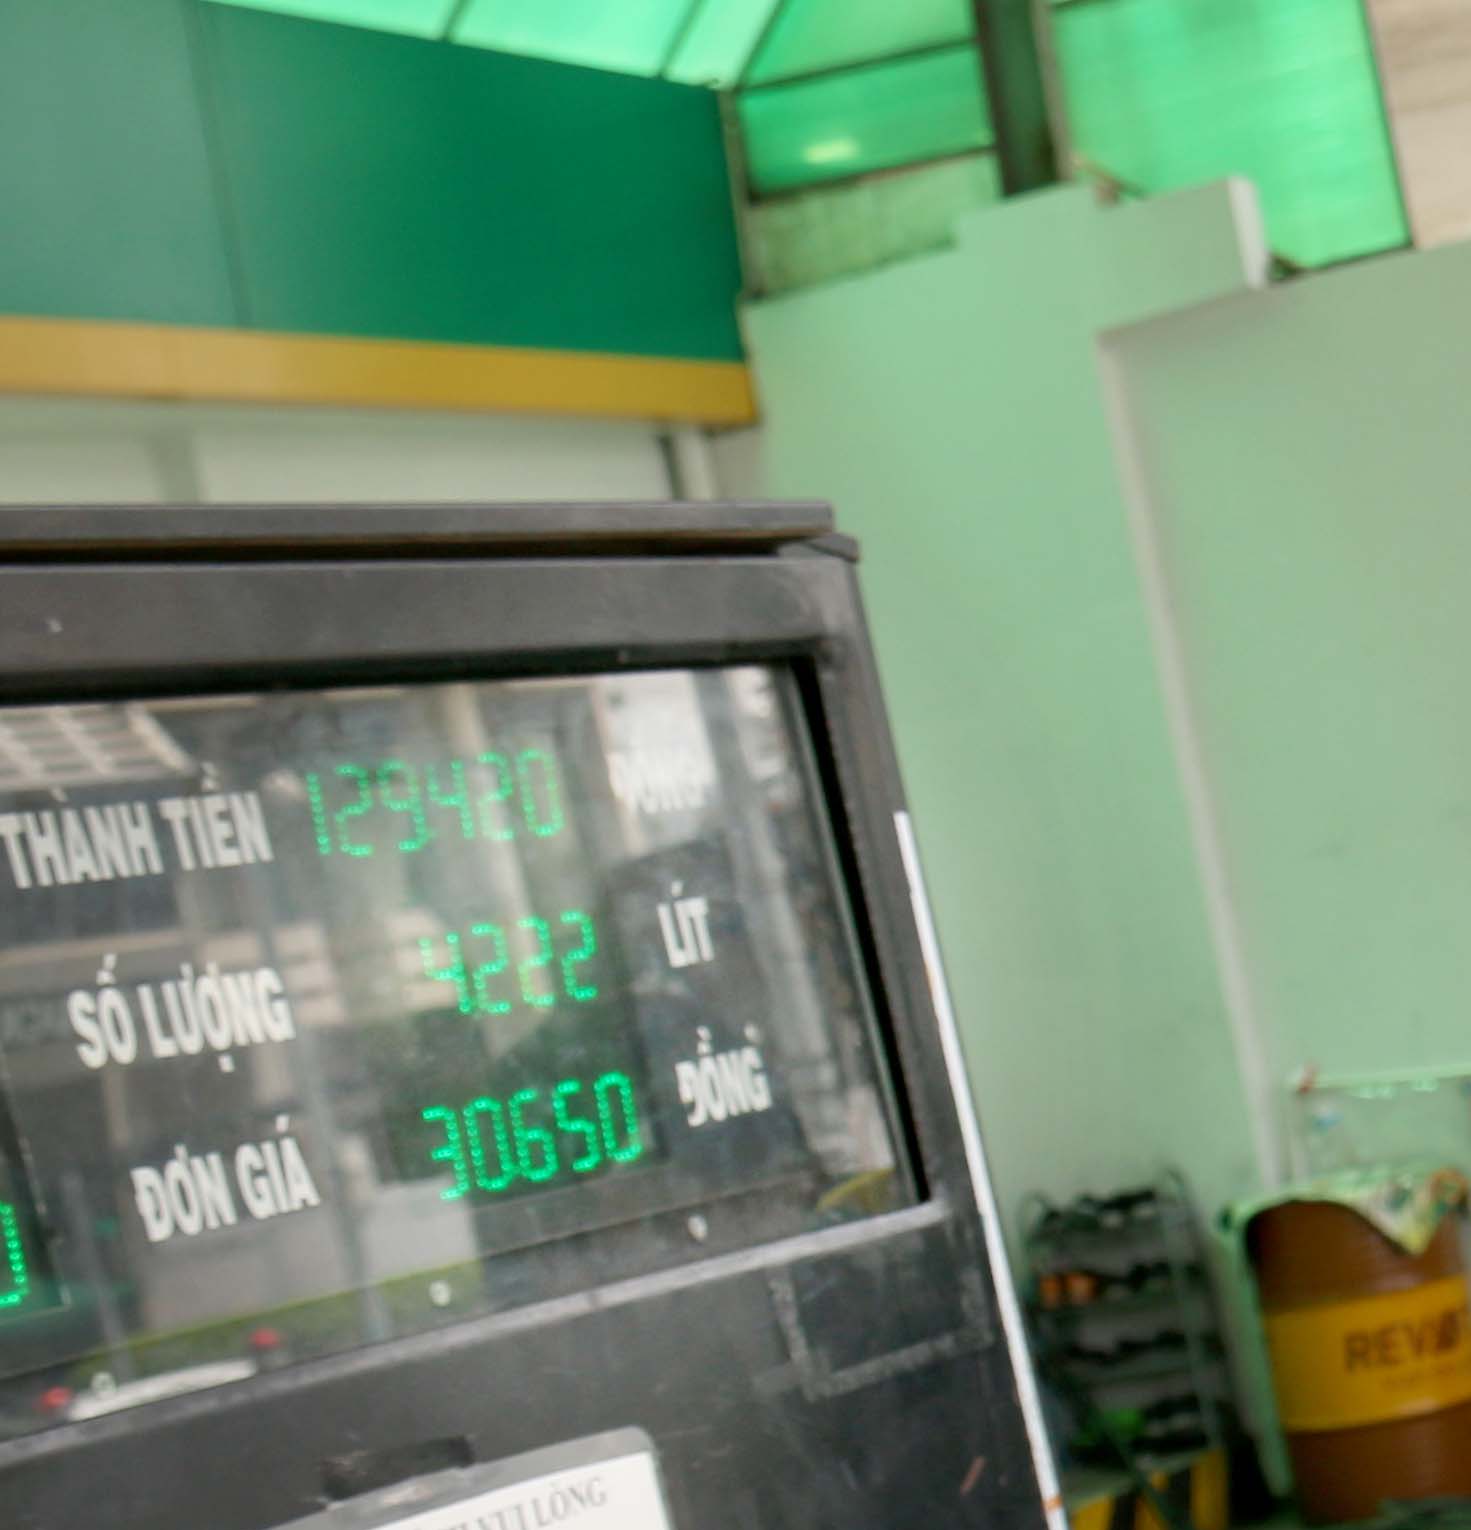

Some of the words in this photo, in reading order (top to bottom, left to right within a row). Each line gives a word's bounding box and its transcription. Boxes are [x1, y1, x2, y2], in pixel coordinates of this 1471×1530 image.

[0, 786, 164, 889] THÀNH
[157, 761, 274, 872] TIỀN
[67, 953, 137, 1068] SỐ
[137, 962, 297, 1072] LƯỢNG
[657, 880, 714, 968] LÍT
[131, 1144, 237, 1242] ĐƠN
[235, 1115, 320, 1219] GIÁ
[421, 1071, 643, 1201] 30650
[675, 1024, 772, 1127] ĐỒNG
[534, 1476, 607, 1529] LÒNG
